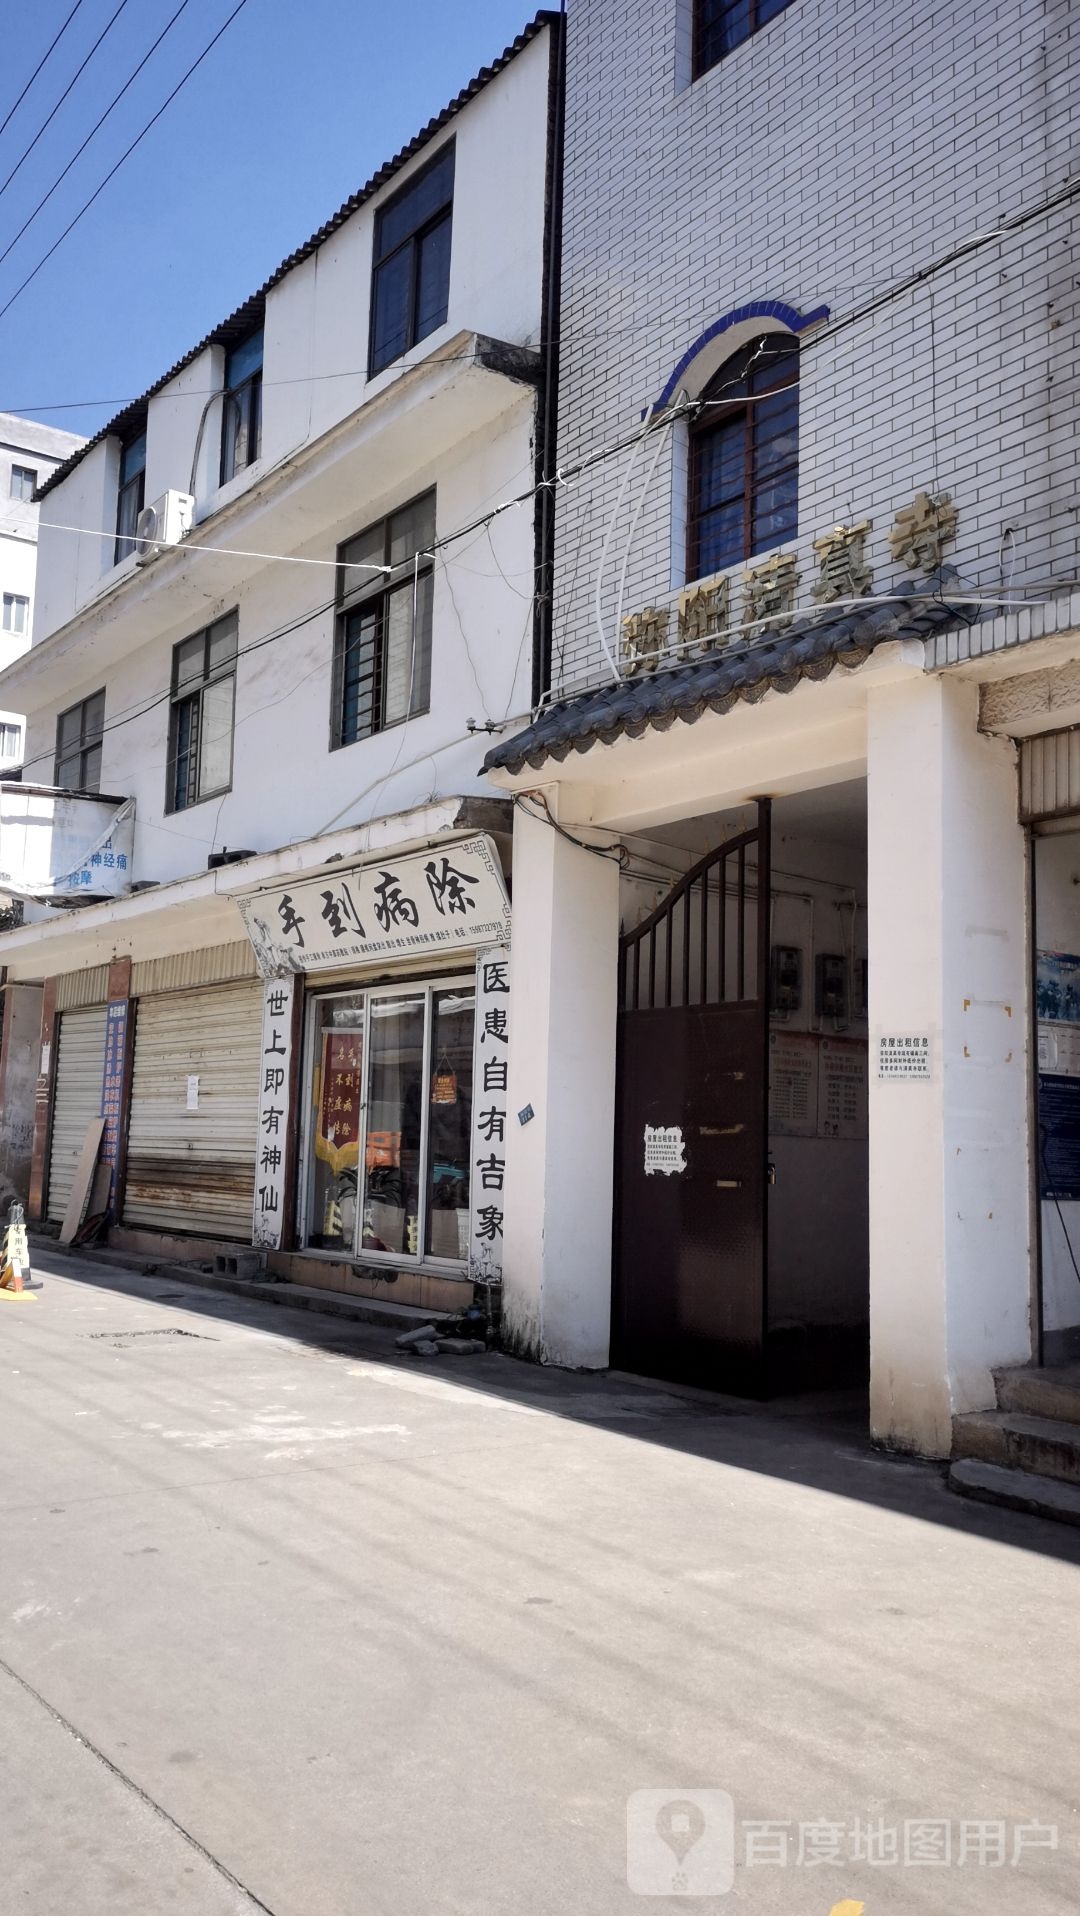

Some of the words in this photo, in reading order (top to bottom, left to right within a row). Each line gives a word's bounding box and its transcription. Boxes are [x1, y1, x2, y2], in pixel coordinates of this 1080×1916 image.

[277, 858, 480, 948] 手到病除
[258, 989, 289, 1213] 世上即有神仙
[475, 961, 510, 1241] 医患自有吉象
[880, 1038, 929, 1048] 房屋出租信息
